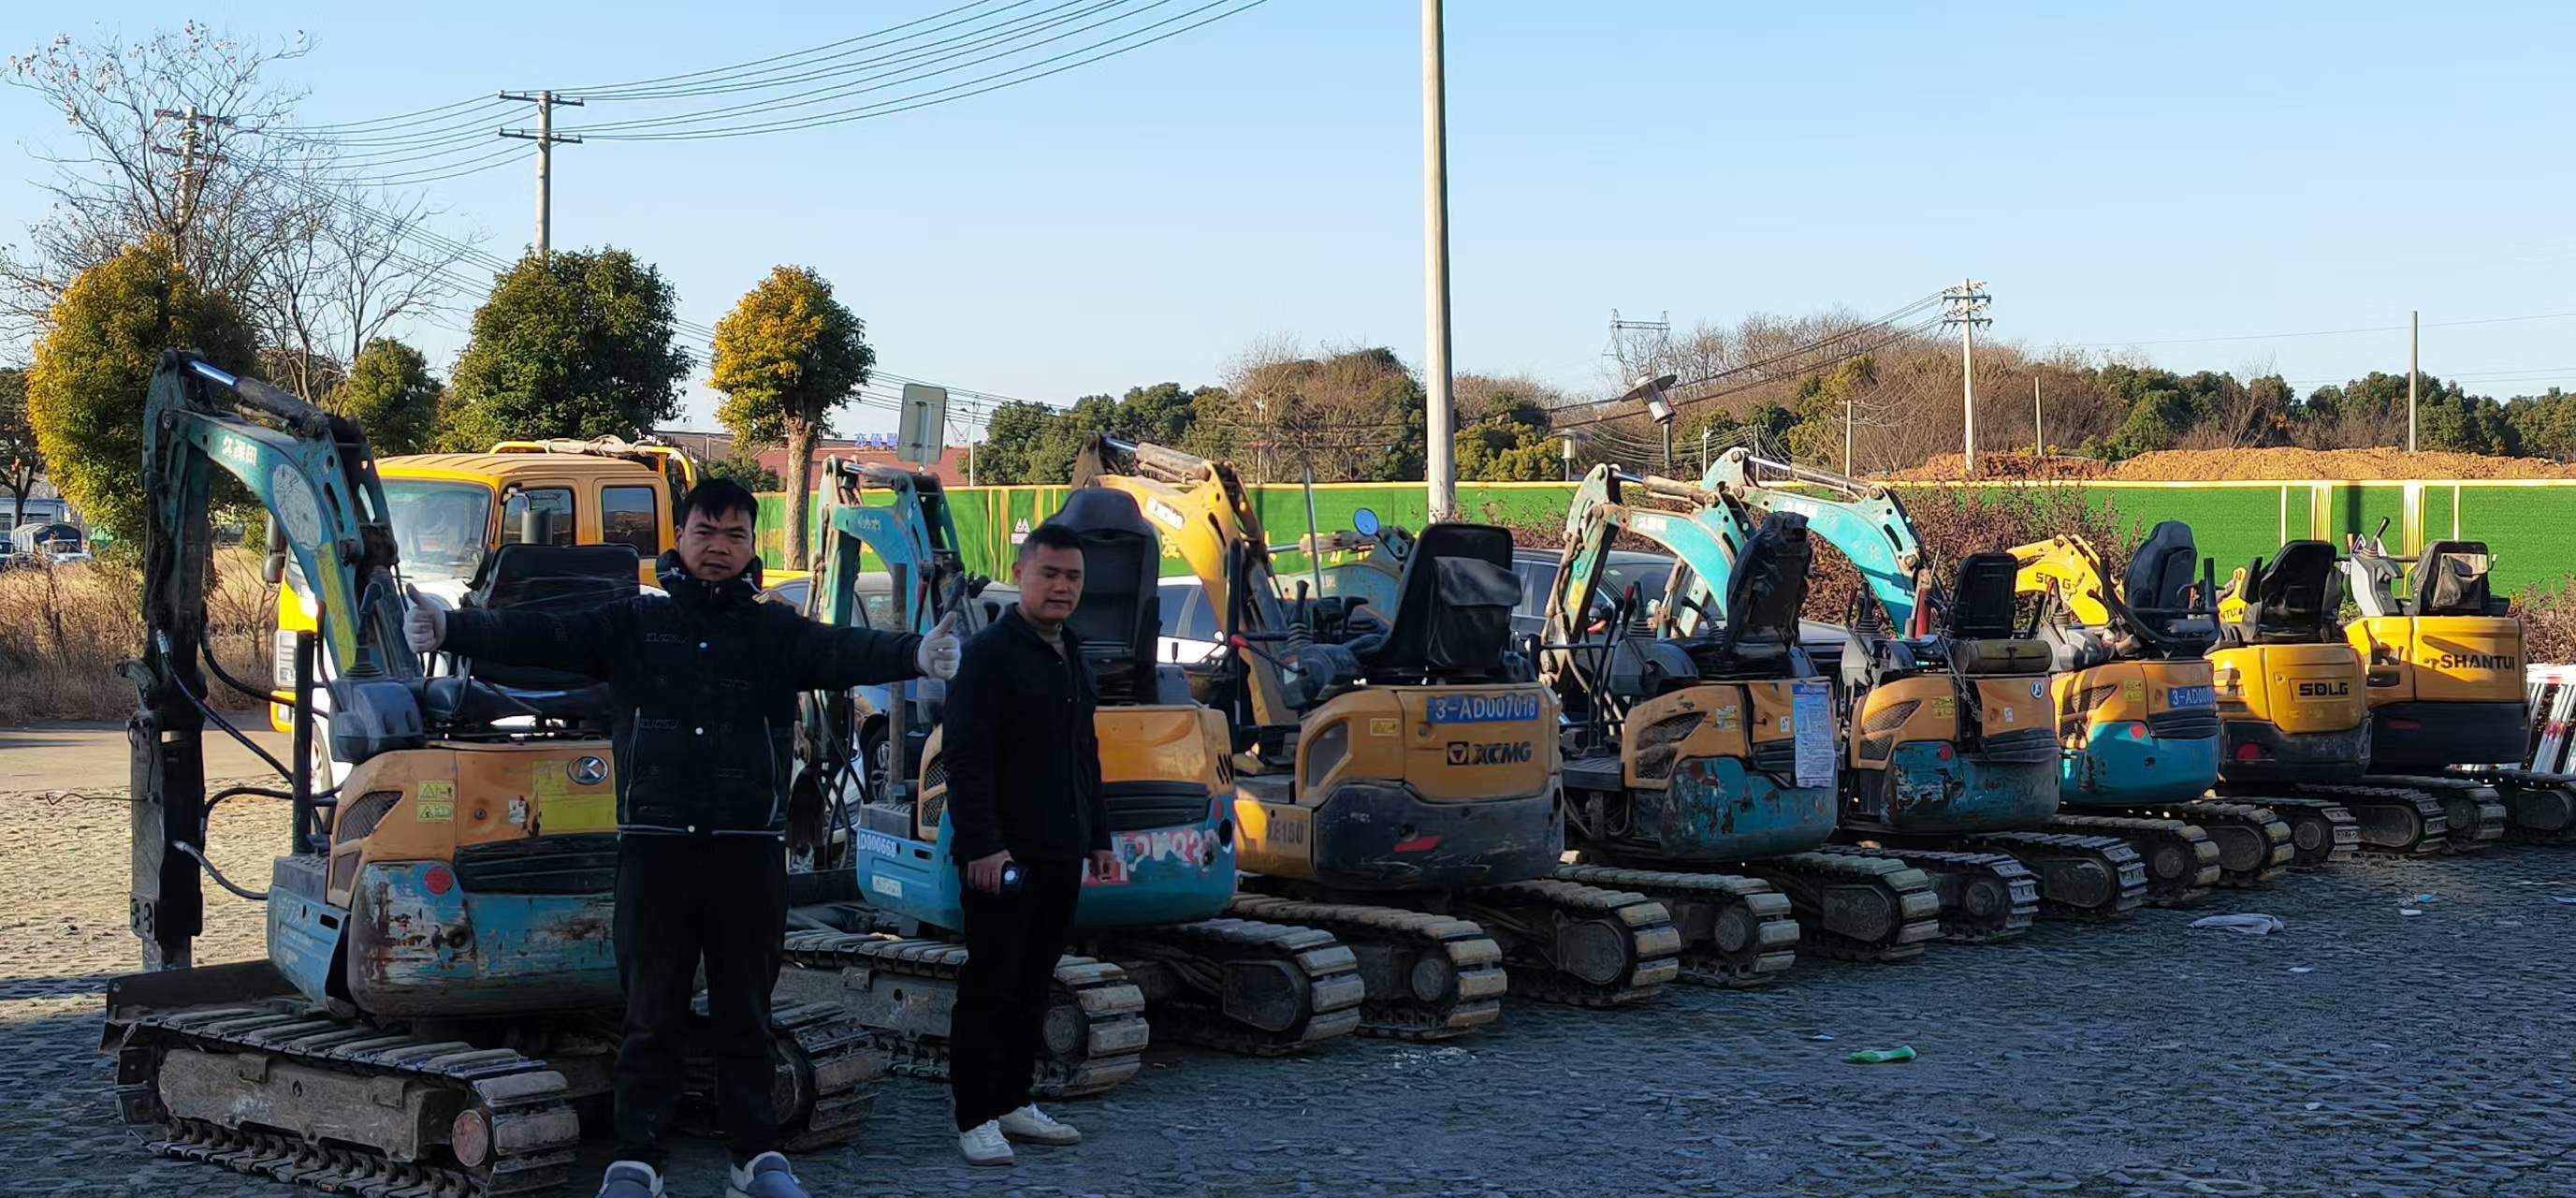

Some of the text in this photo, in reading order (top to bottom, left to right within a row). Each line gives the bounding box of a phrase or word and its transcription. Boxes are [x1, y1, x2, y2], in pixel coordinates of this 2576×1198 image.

[2440, 654, 2515, 671] SHANTUI
[2299, 681, 2349, 696] SDLG
[1471, 741, 1533, 765] XCMG
